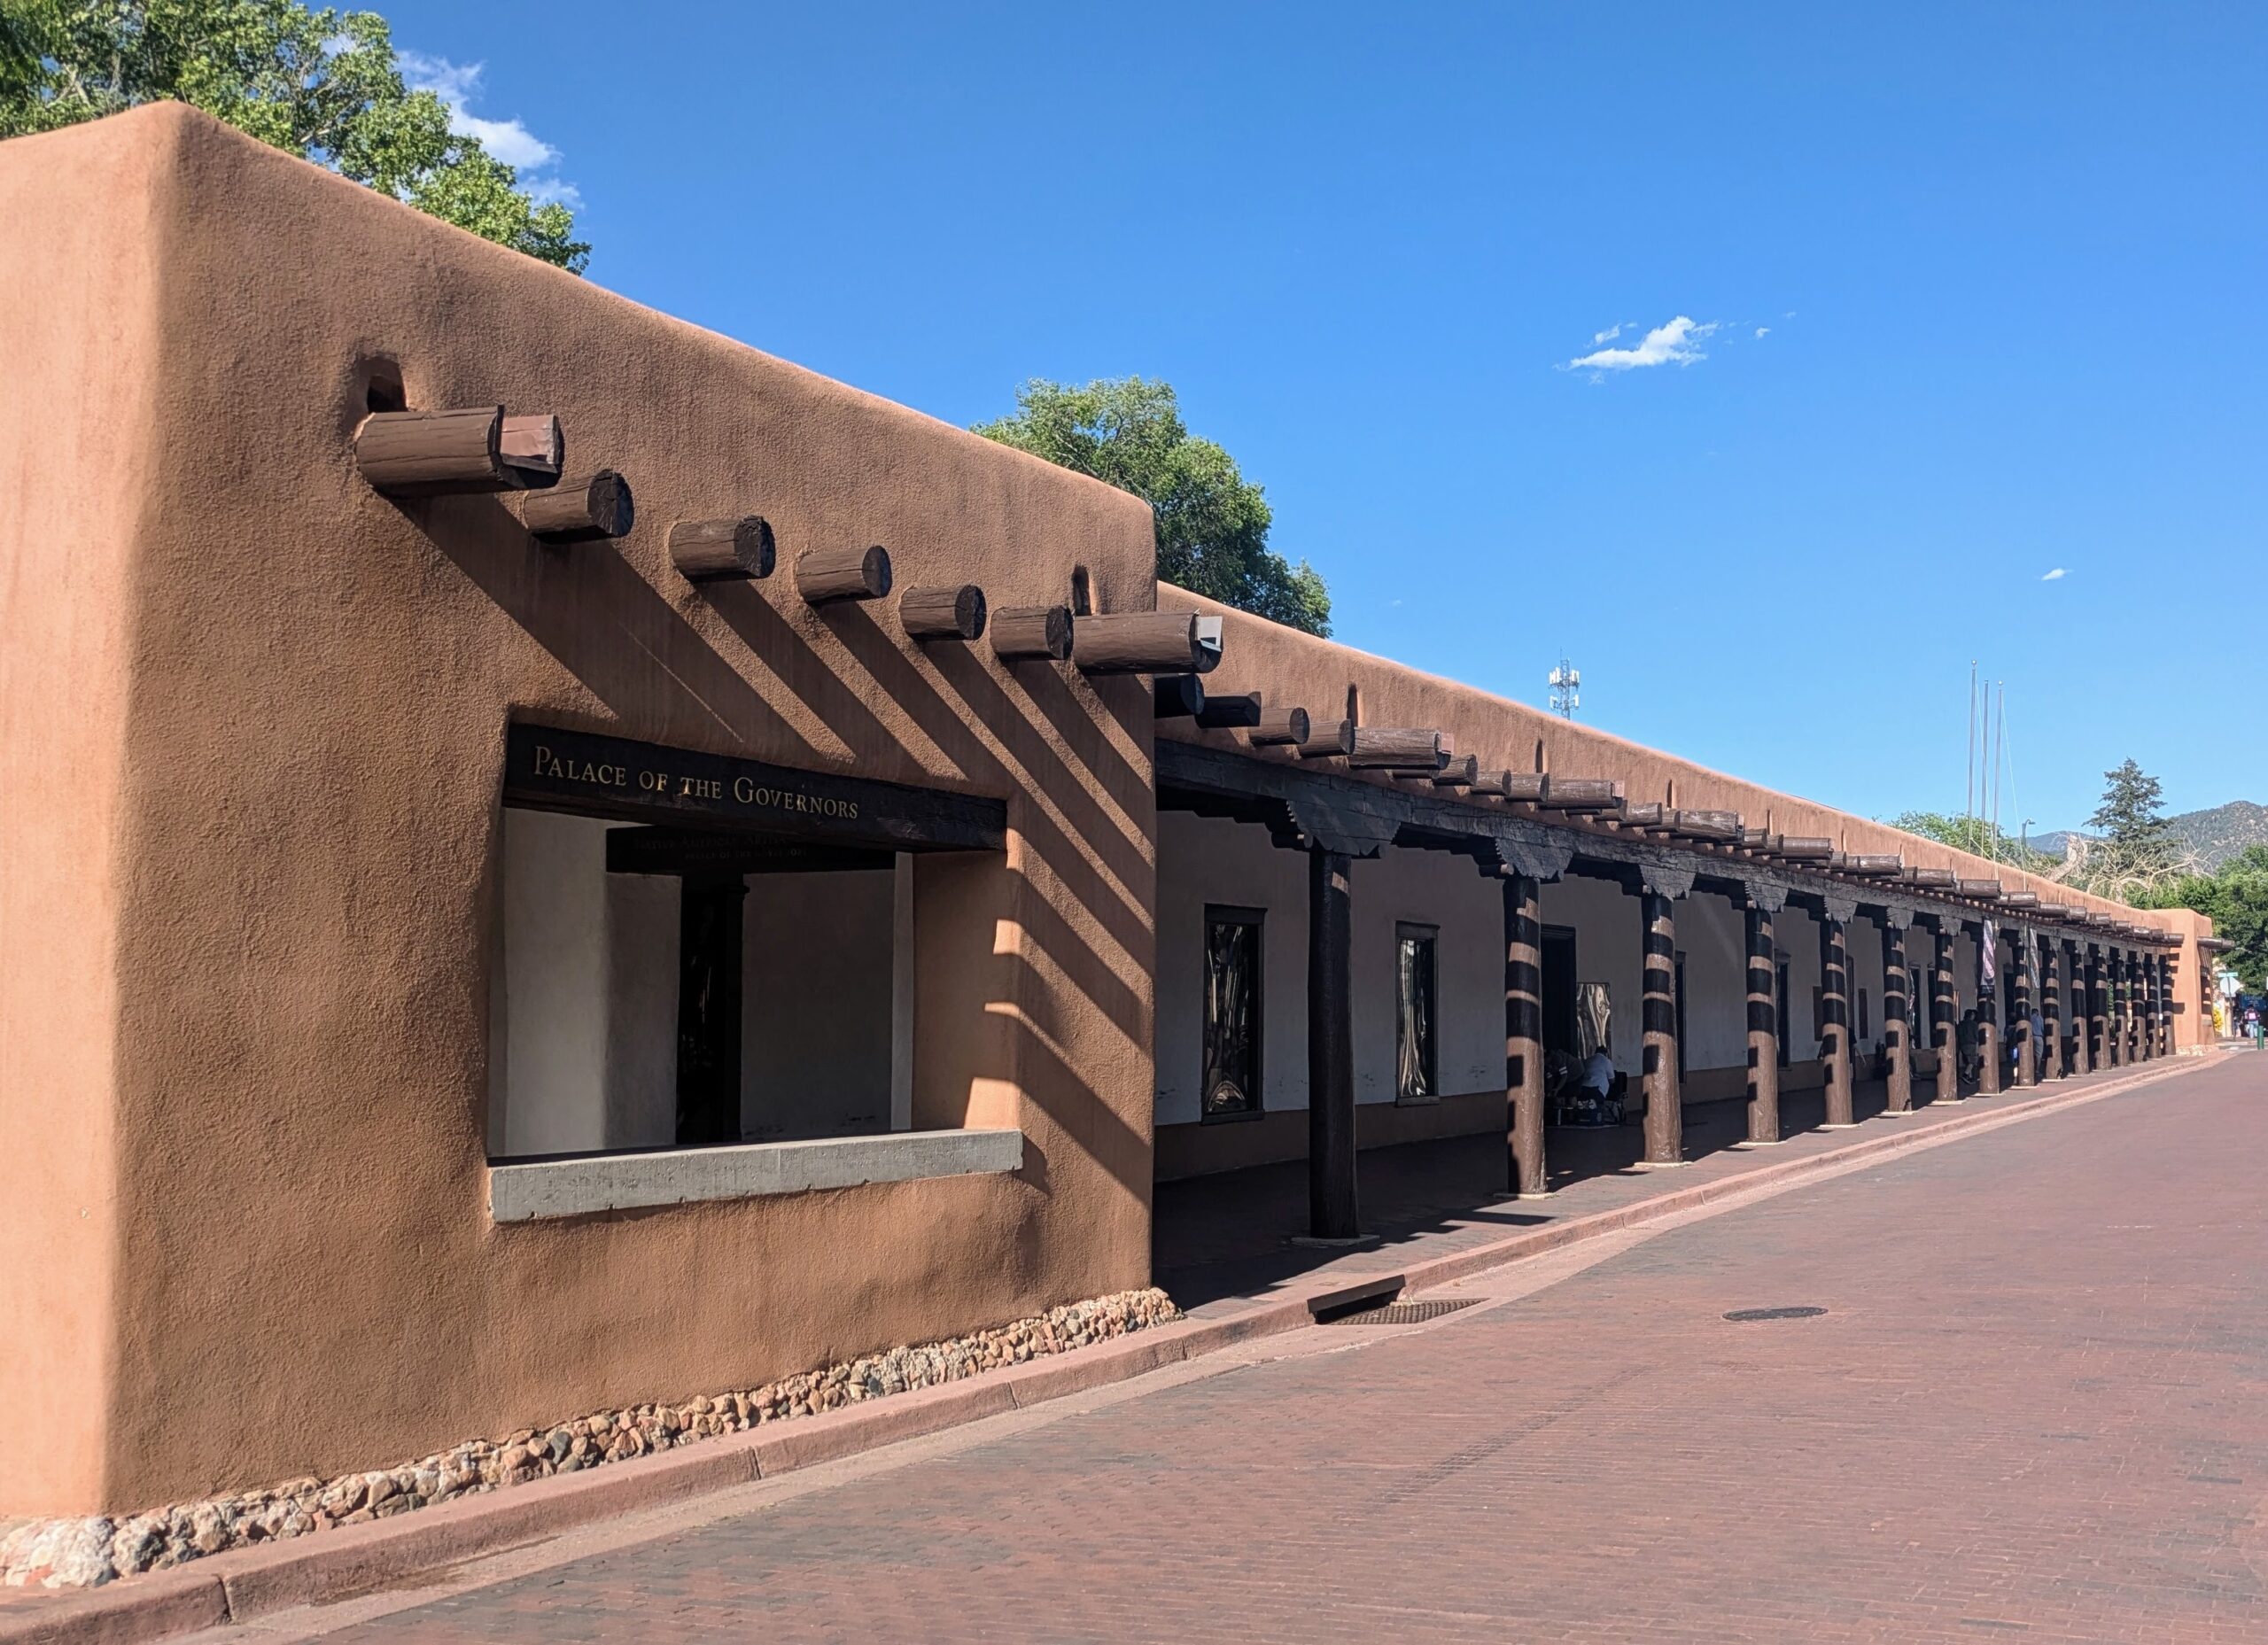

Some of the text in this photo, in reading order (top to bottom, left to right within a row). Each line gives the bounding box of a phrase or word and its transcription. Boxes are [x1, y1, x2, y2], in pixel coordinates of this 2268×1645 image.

[533, 745, 859, 819] PALACE OF THE GOVERNORS
